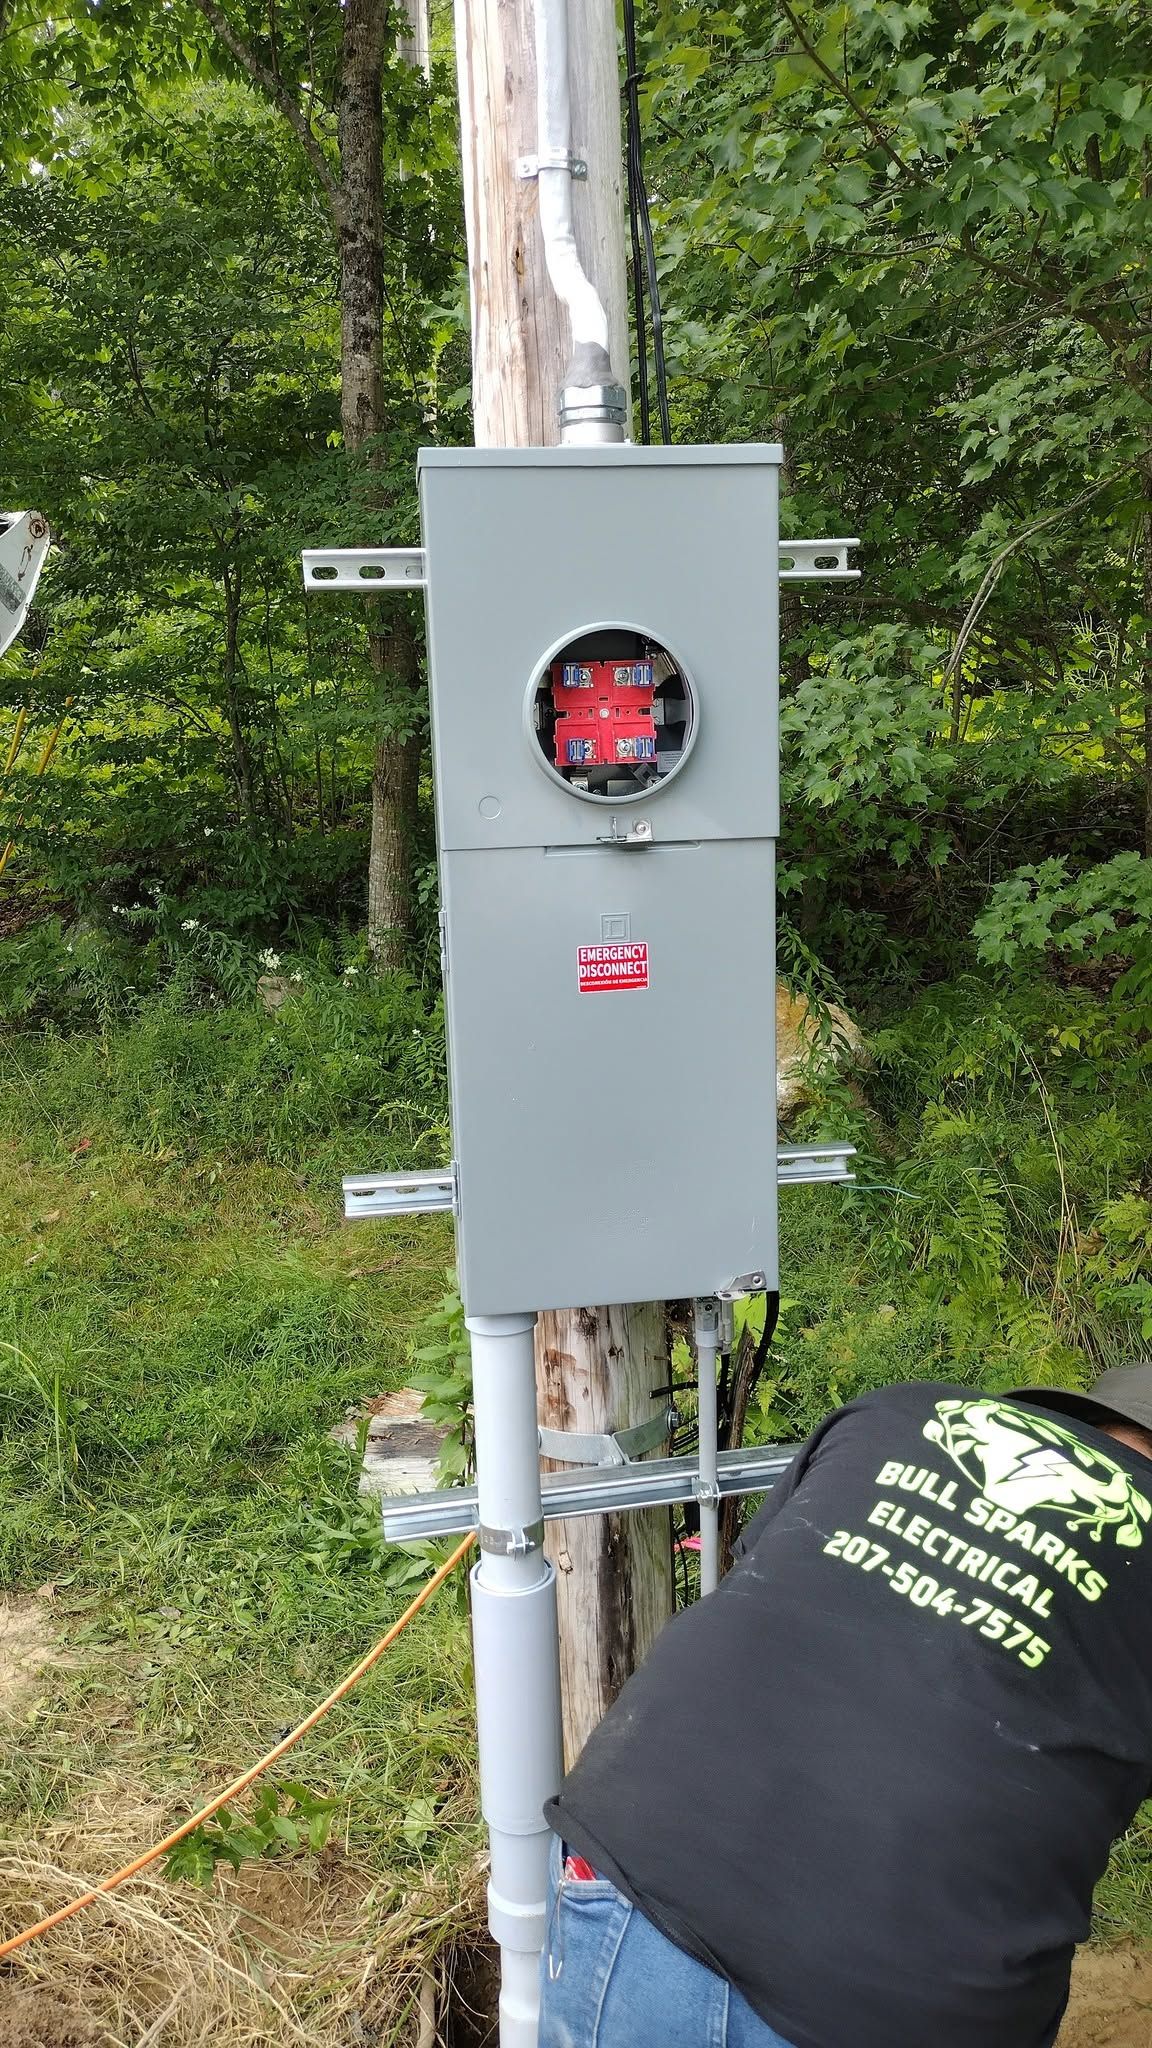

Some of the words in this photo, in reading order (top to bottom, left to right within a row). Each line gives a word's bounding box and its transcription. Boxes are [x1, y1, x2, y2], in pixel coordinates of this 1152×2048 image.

[580, 945, 645, 962] EMERGENCY
[580, 961, 647, 978] DISCONNECT
[866, 1500, 1054, 1619] ELECTRICAL
[874, 1461, 960, 1512] BULL
[963, 1497, 1110, 1602] SPARKS
[823, 1530, 1052, 1668] 207-504-7575
